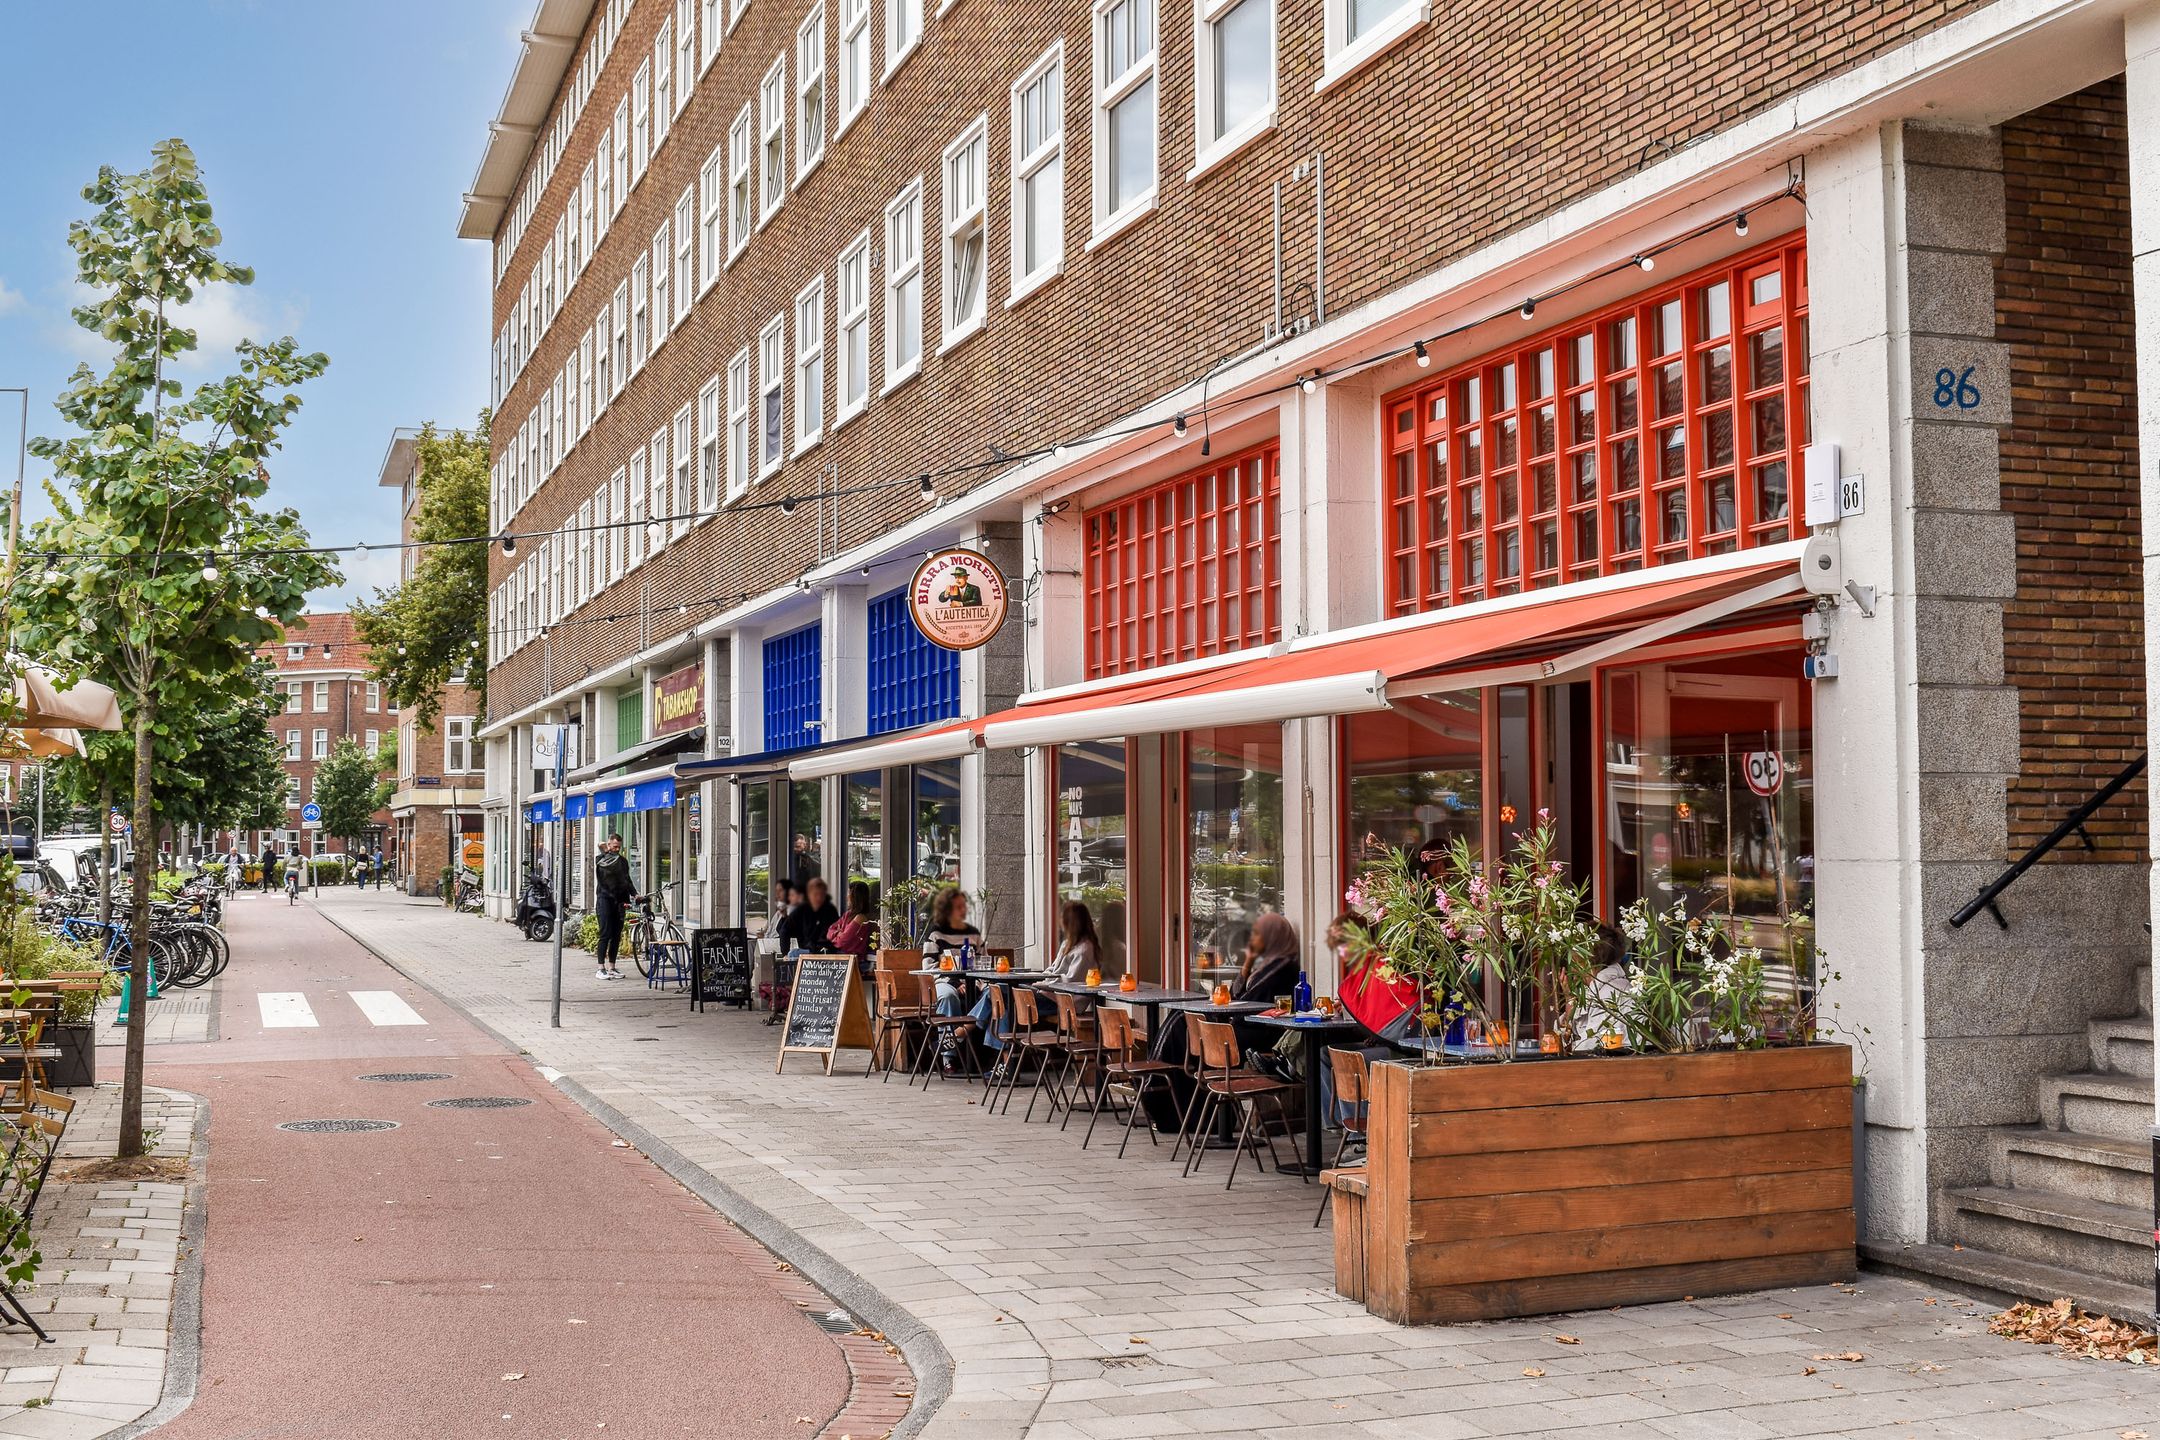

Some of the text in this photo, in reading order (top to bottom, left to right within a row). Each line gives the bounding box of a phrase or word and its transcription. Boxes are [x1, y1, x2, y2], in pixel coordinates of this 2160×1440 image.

[1933, 366, 1981, 409] 86
[1843, 481, 1859, 510] 86
[918, 556, 1002, 605] BIRRA MORETTI
[935, 607, 990, 621] L'AUTENTICA
[663, 685, 698, 722] TABAKSHOP
[536, 743, 575, 757] QUES
[719, 739, 730, 747] 102
[1068, 786, 1083, 800] NO
[113, 817, 124, 826] 30
[1068, 816, 1083, 888] ART
[818, 969, 833, 979] daily
[800, 978, 827, 987] monday
[796, 1004, 823, 1014] sunday
